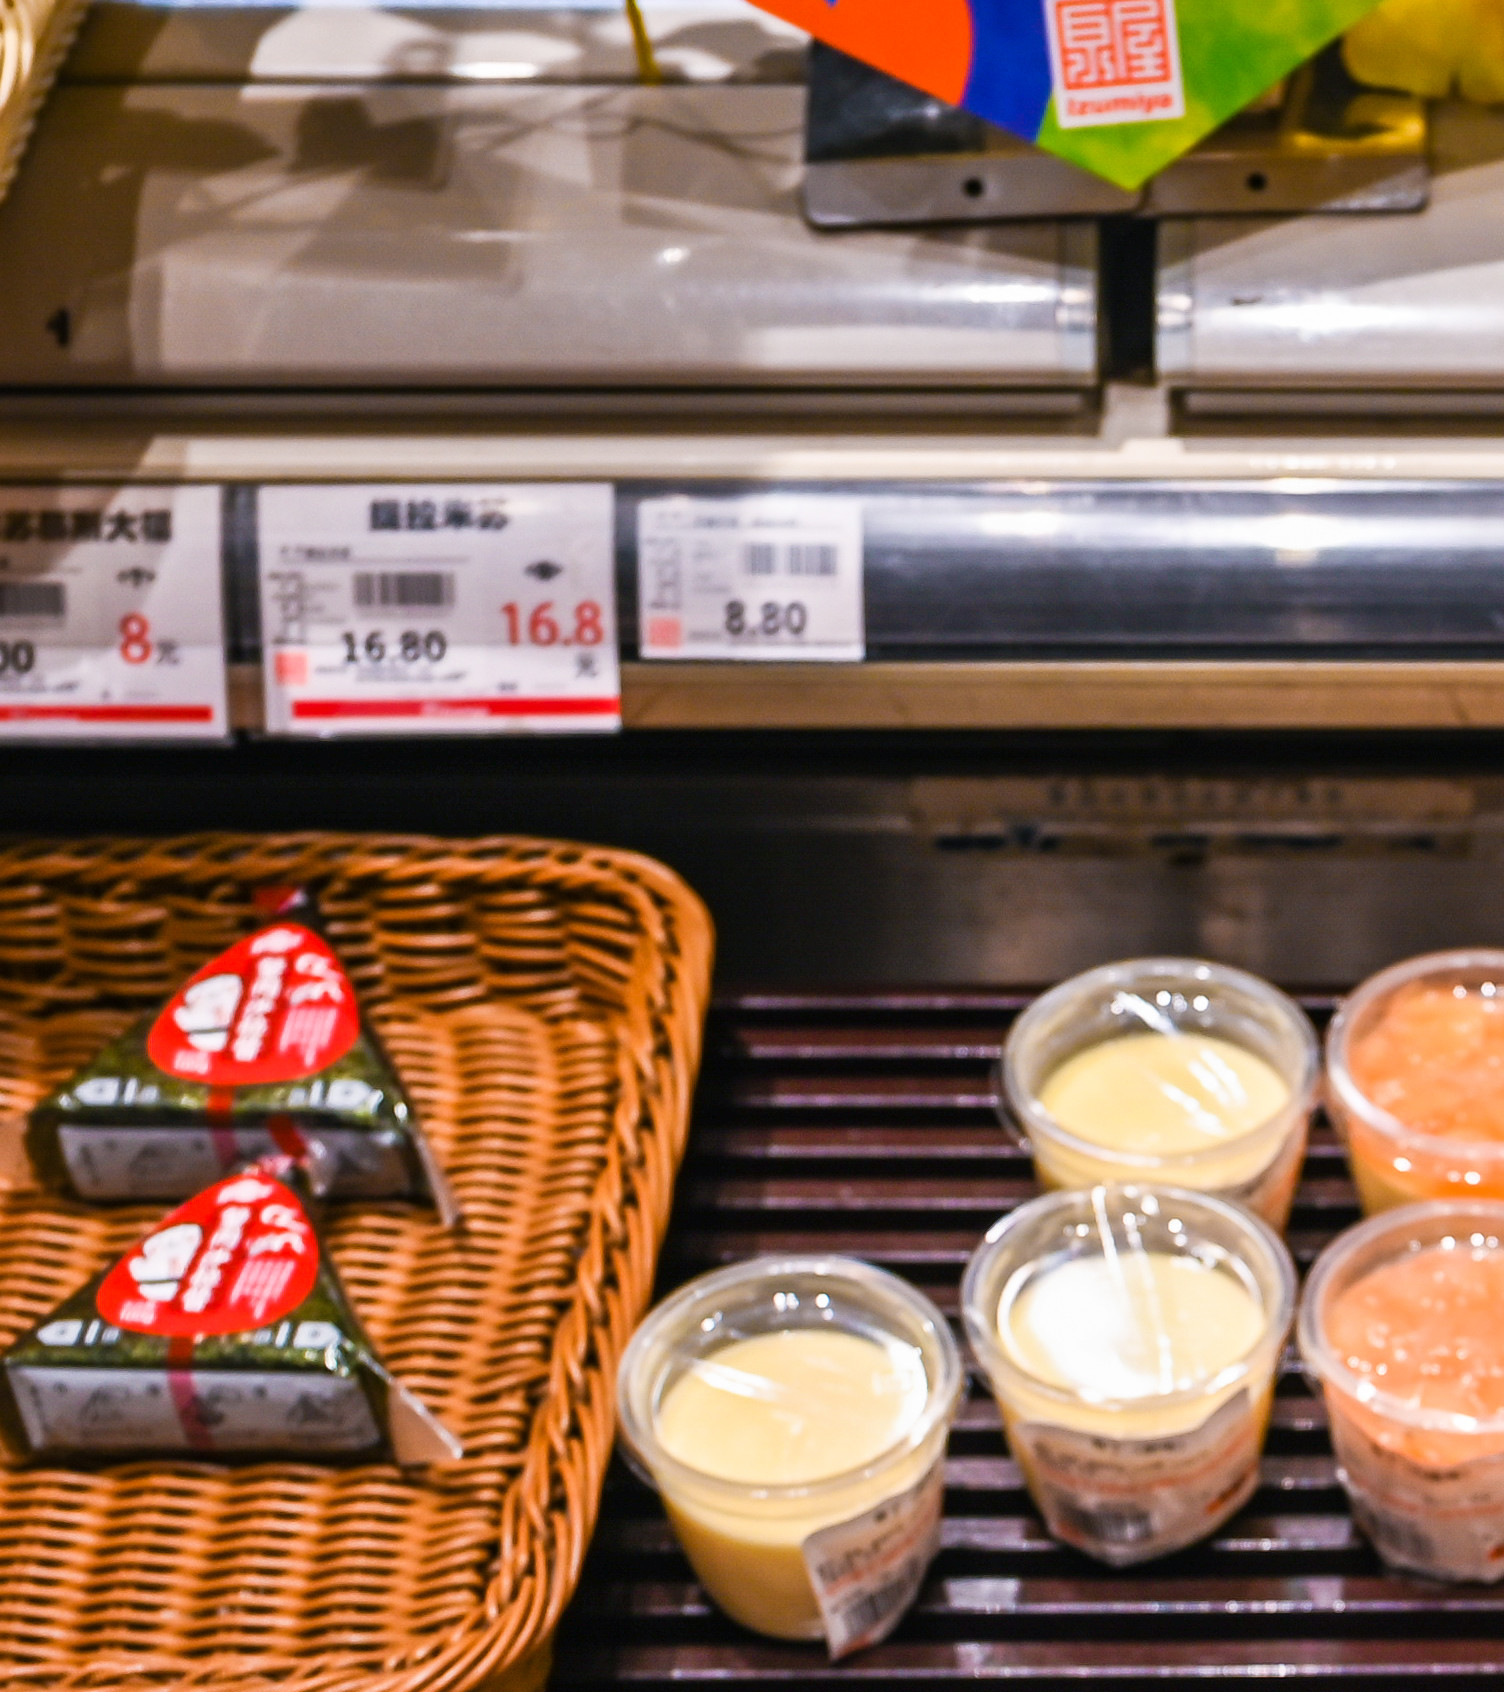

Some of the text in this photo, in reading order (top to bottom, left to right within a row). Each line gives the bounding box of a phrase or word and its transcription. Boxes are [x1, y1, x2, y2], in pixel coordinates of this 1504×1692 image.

[119, 611, 153, 664] 8
[500, 600, 605, 648] 16.8
[724, 601, 807, 636] 8.80
[341, 630, 447, 663] 16.80
